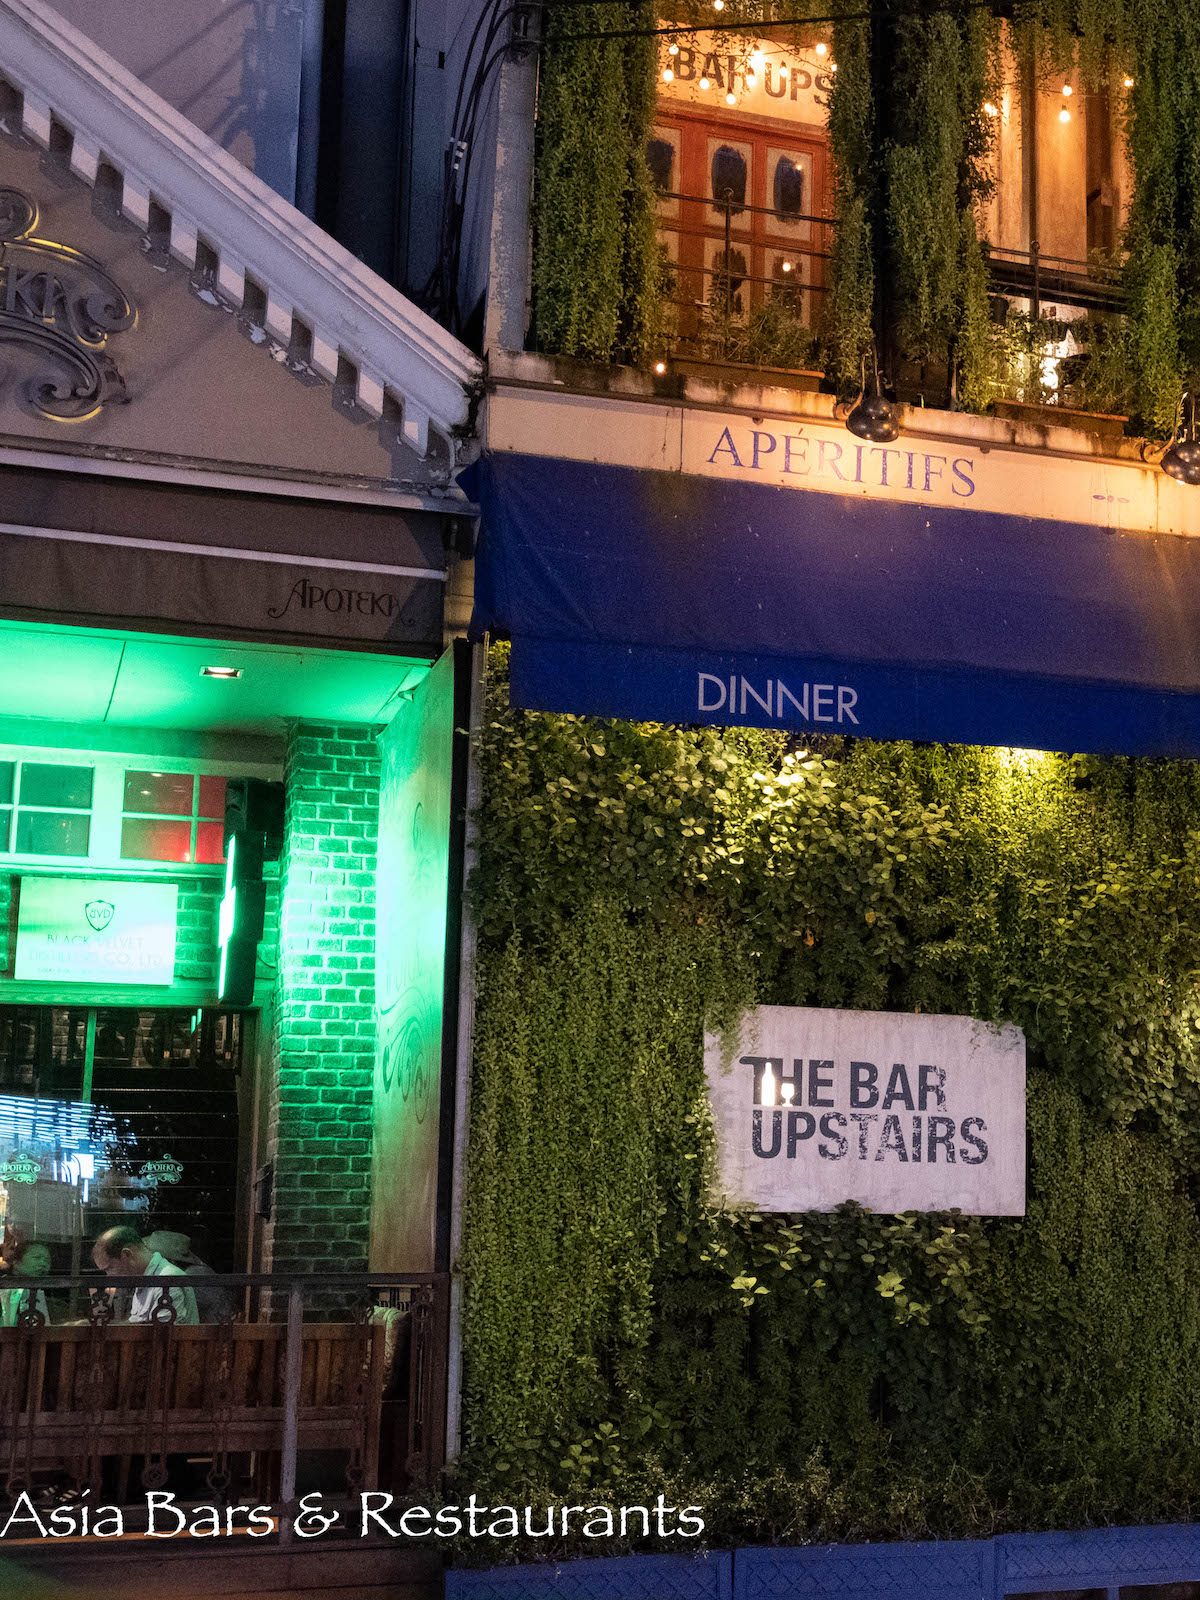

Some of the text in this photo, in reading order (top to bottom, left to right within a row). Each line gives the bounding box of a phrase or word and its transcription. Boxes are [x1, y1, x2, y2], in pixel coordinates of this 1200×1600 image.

[707, 426, 976, 497] APÉRITIFS
[697, 671, 860, 725] DINNER
[739, 1055, 948, 1113] THE BAR
[752, 1109, 989, 1165] UPSTAIRS
